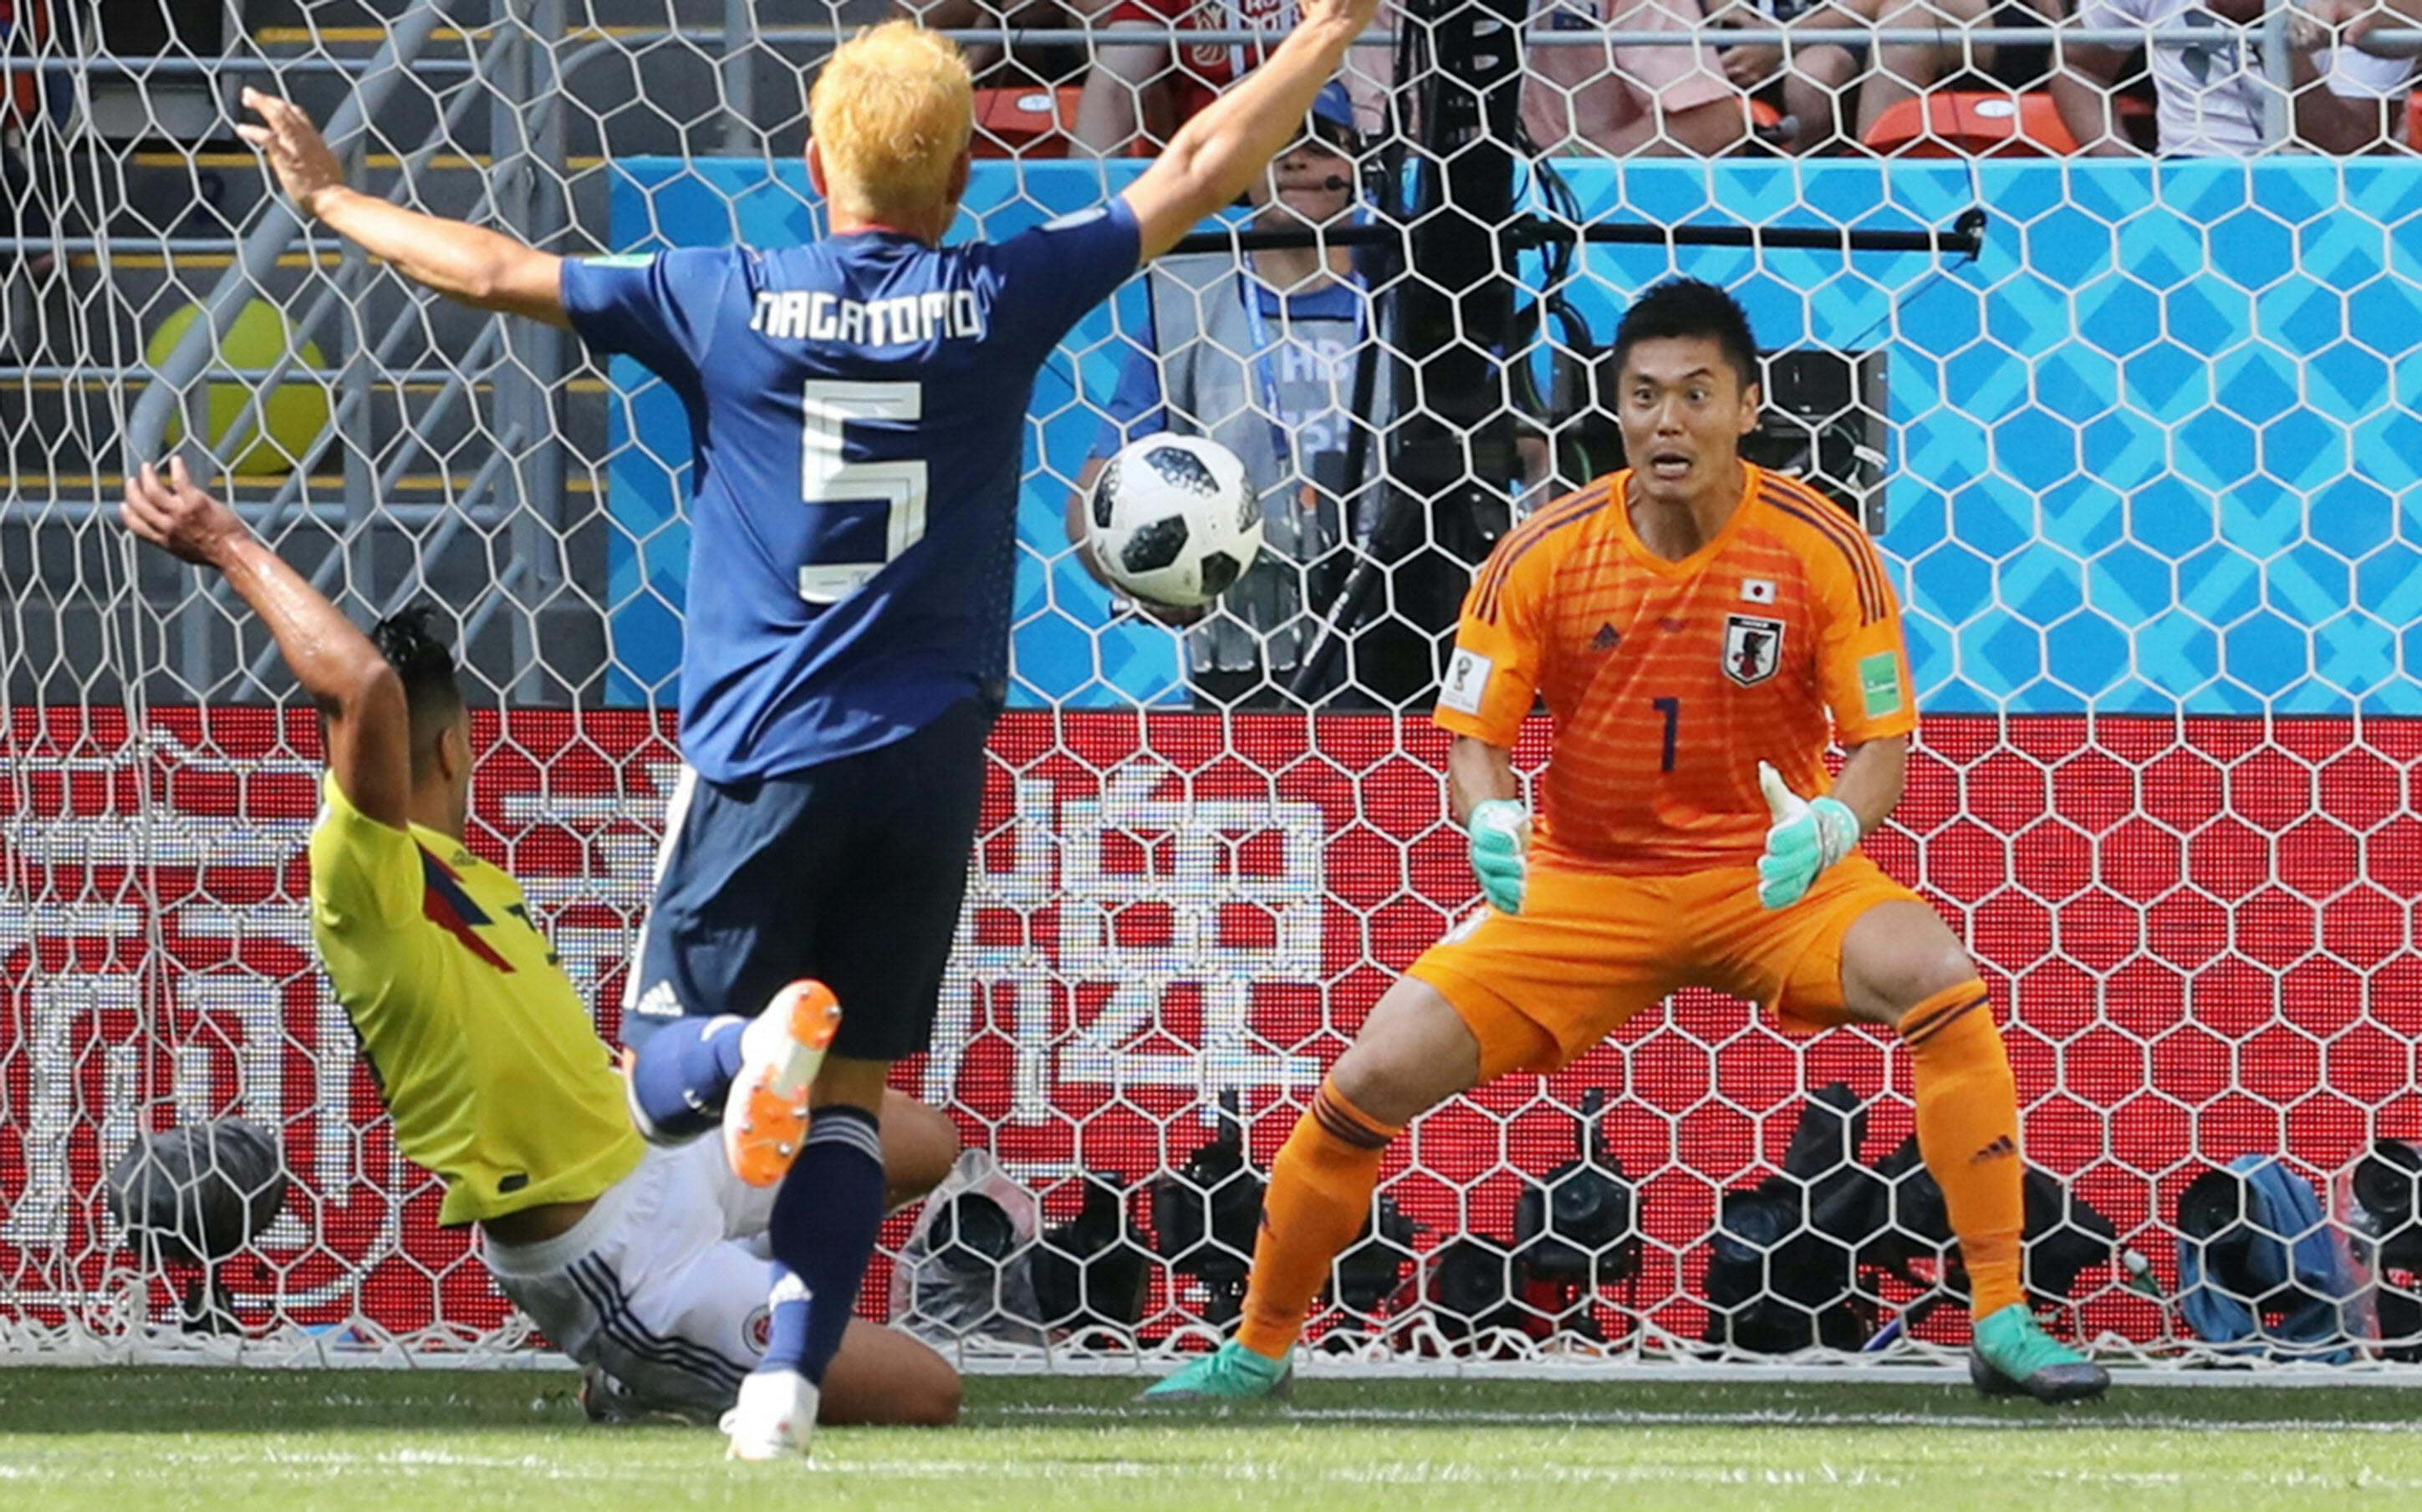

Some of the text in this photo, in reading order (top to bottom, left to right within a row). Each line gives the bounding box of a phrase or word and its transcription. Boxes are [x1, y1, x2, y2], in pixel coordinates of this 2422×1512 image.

[749, 290, 982, 347] NAGATOMO
[799, 379, 928, 603] 5
[1653, 696, 1679, 774] 1
